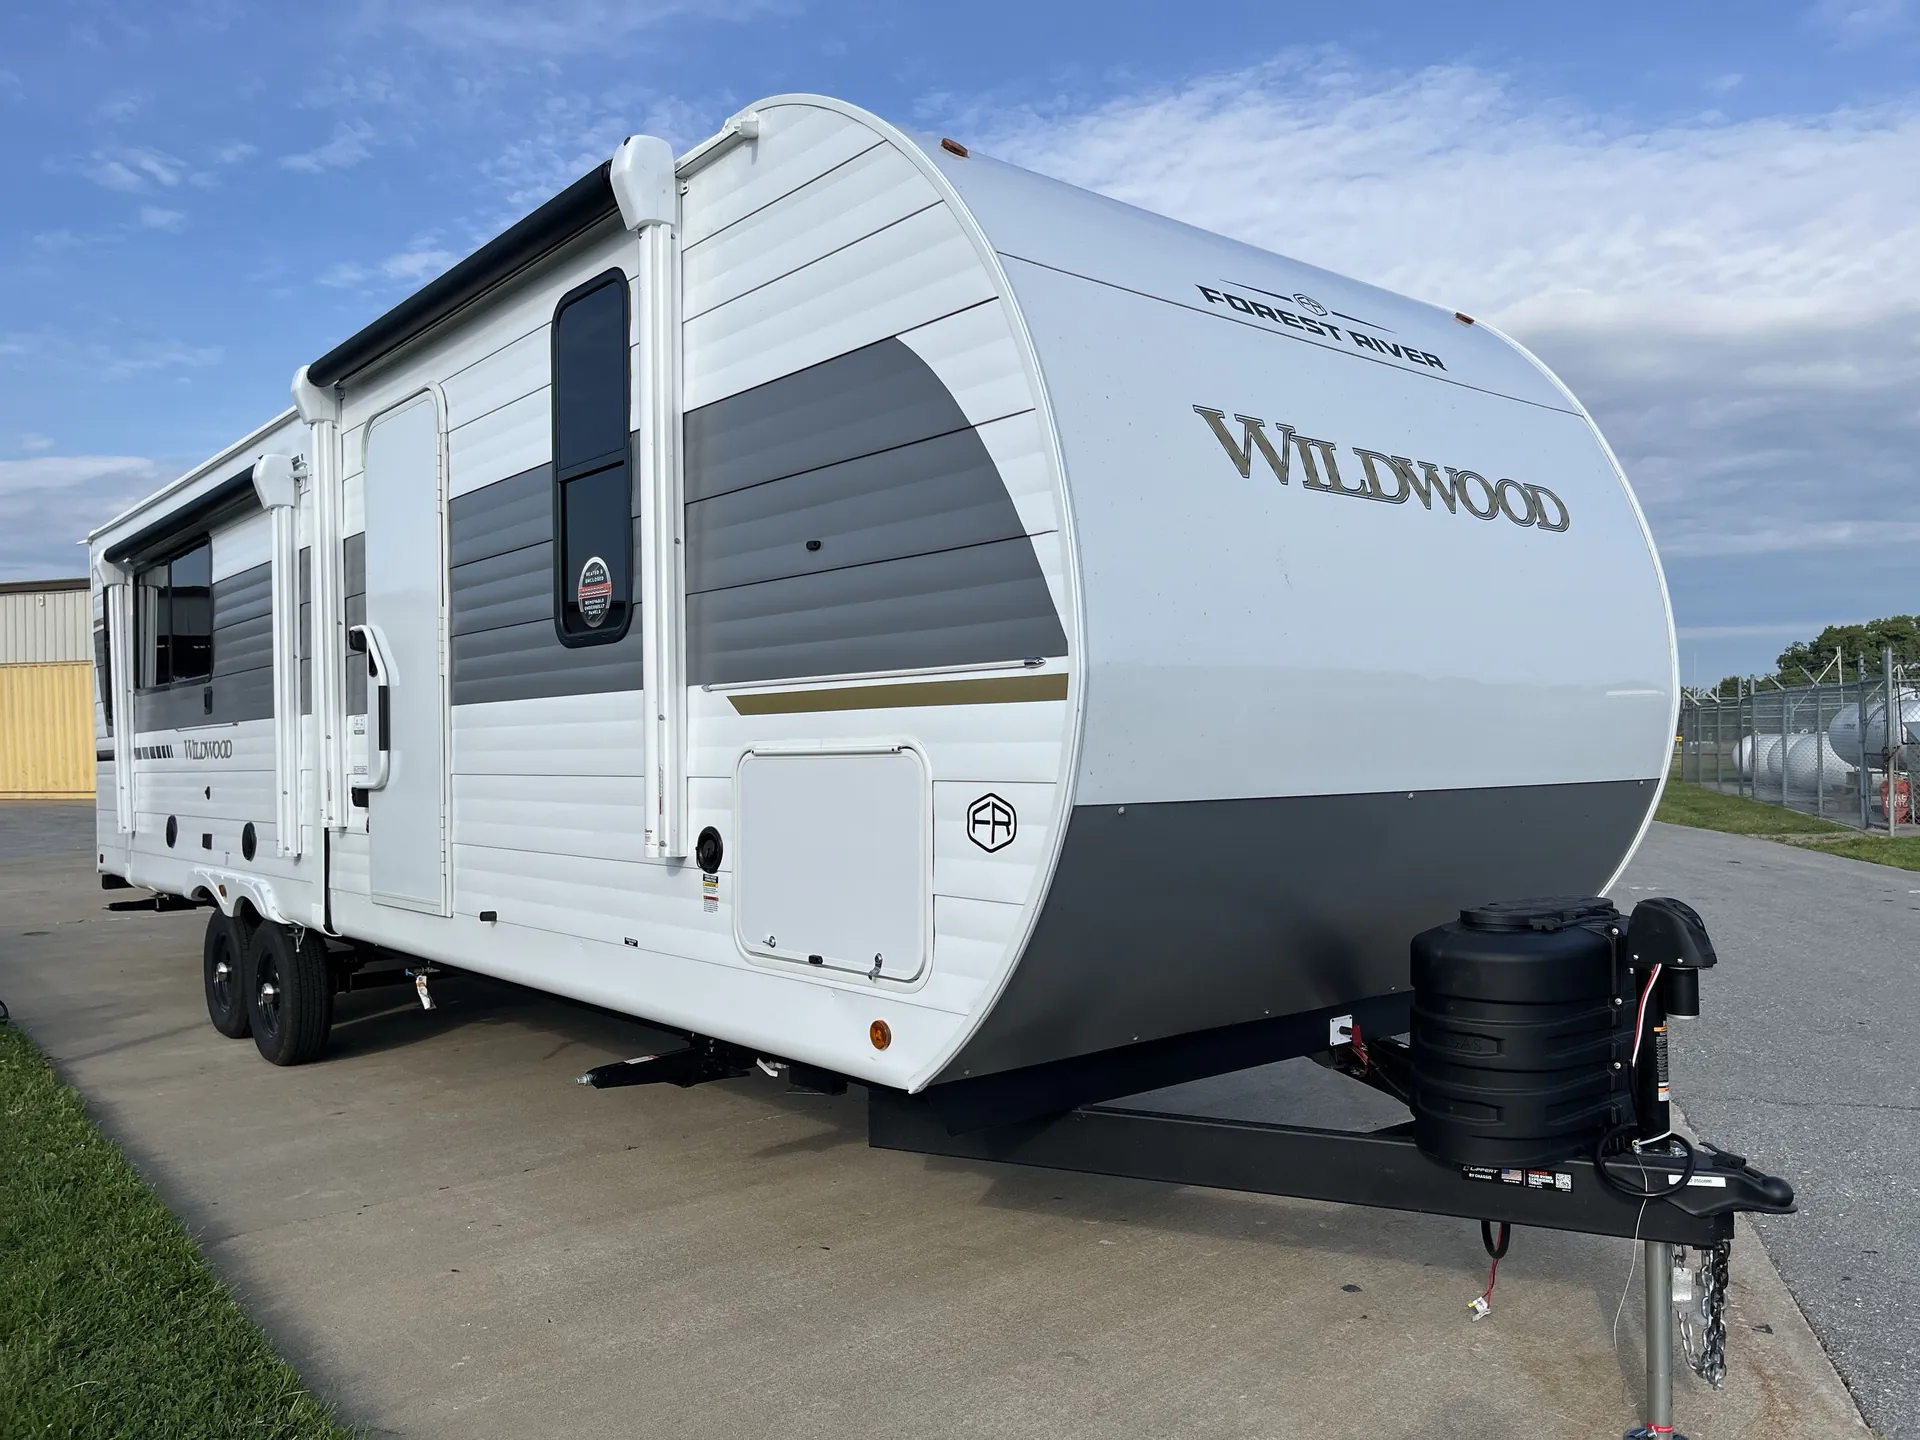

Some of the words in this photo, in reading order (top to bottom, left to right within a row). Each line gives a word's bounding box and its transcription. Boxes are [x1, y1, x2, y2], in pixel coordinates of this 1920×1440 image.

[1195, 284, 1343, 341] FOREST
[1345, 329, 1448, 371] RIVER
[1192, 404, 1571, 533] WILDWOOD
[184, 739, 233, 760] WILDWOOD
[1470, 1166, 1498, 1174] LIPPERT
